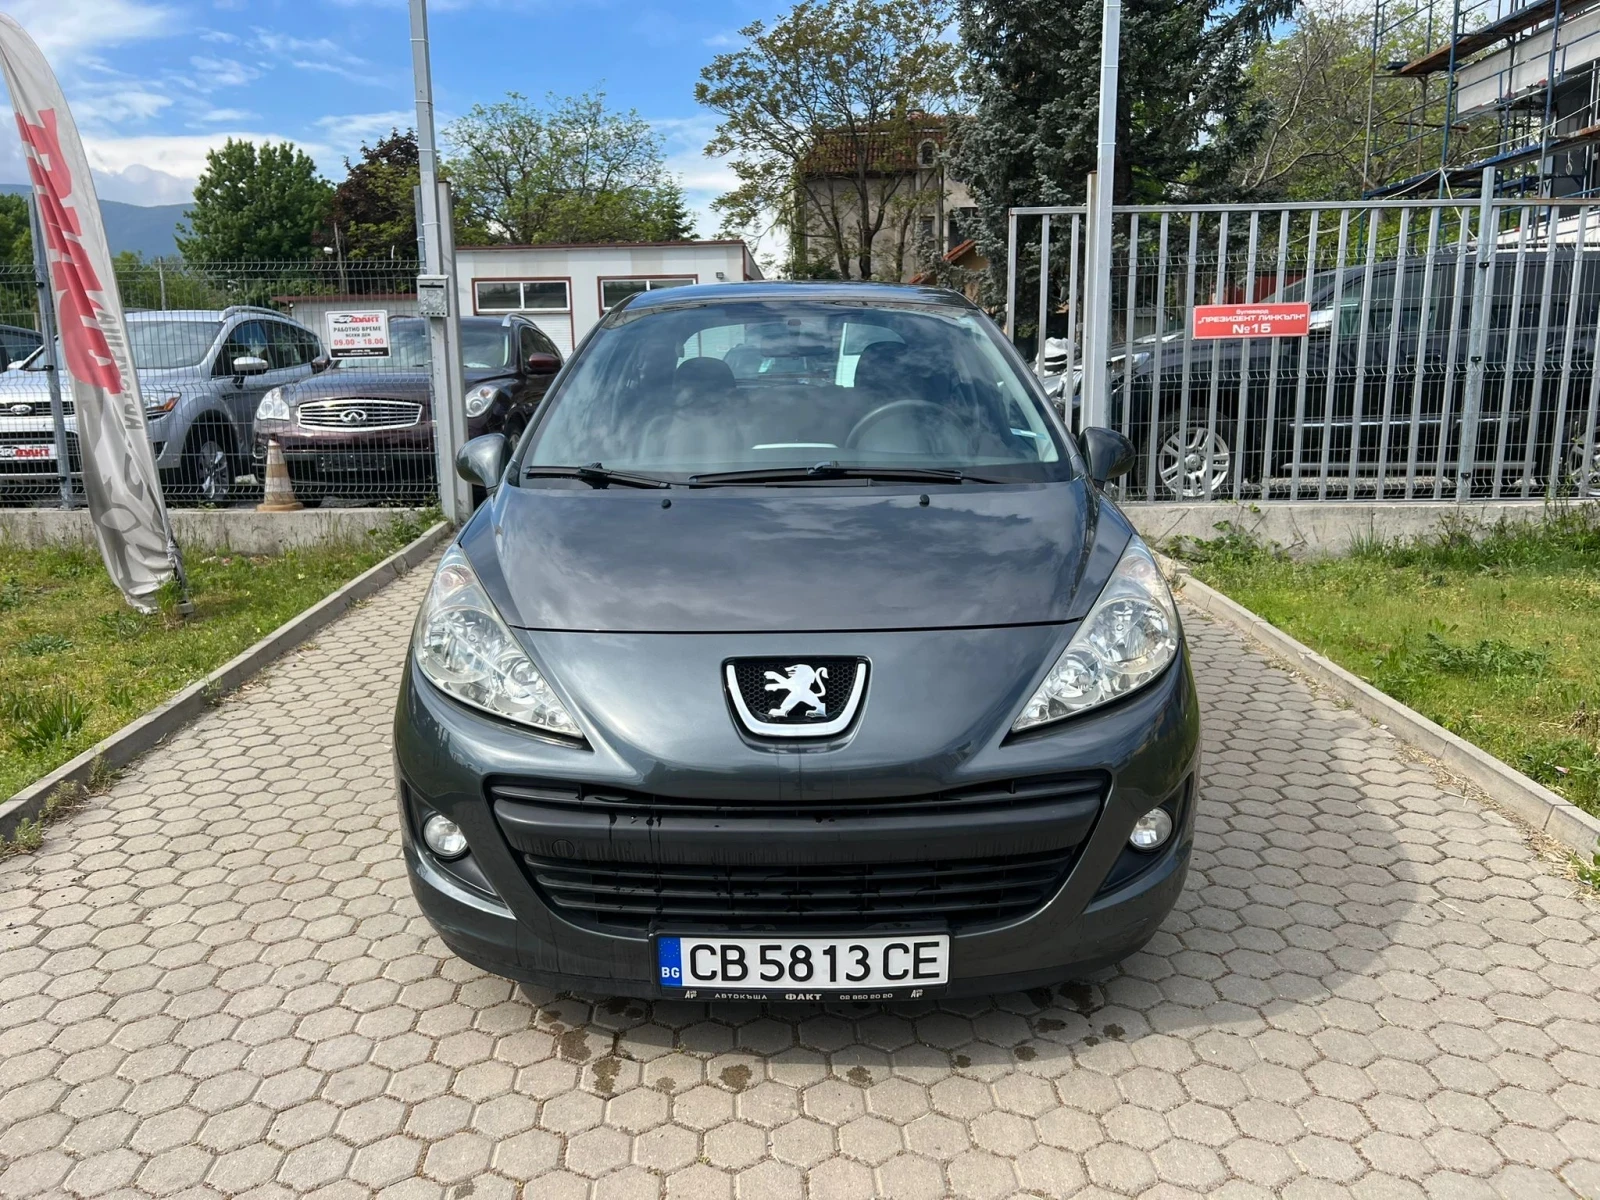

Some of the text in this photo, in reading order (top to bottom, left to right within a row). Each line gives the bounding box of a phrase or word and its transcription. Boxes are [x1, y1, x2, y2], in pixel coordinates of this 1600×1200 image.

[333, 338, 355, 346] 09.00
[363, 337, 384, 345] 18.00
[759, 944, 871, 983] 5813
[661, 966, 680, 979] BG
